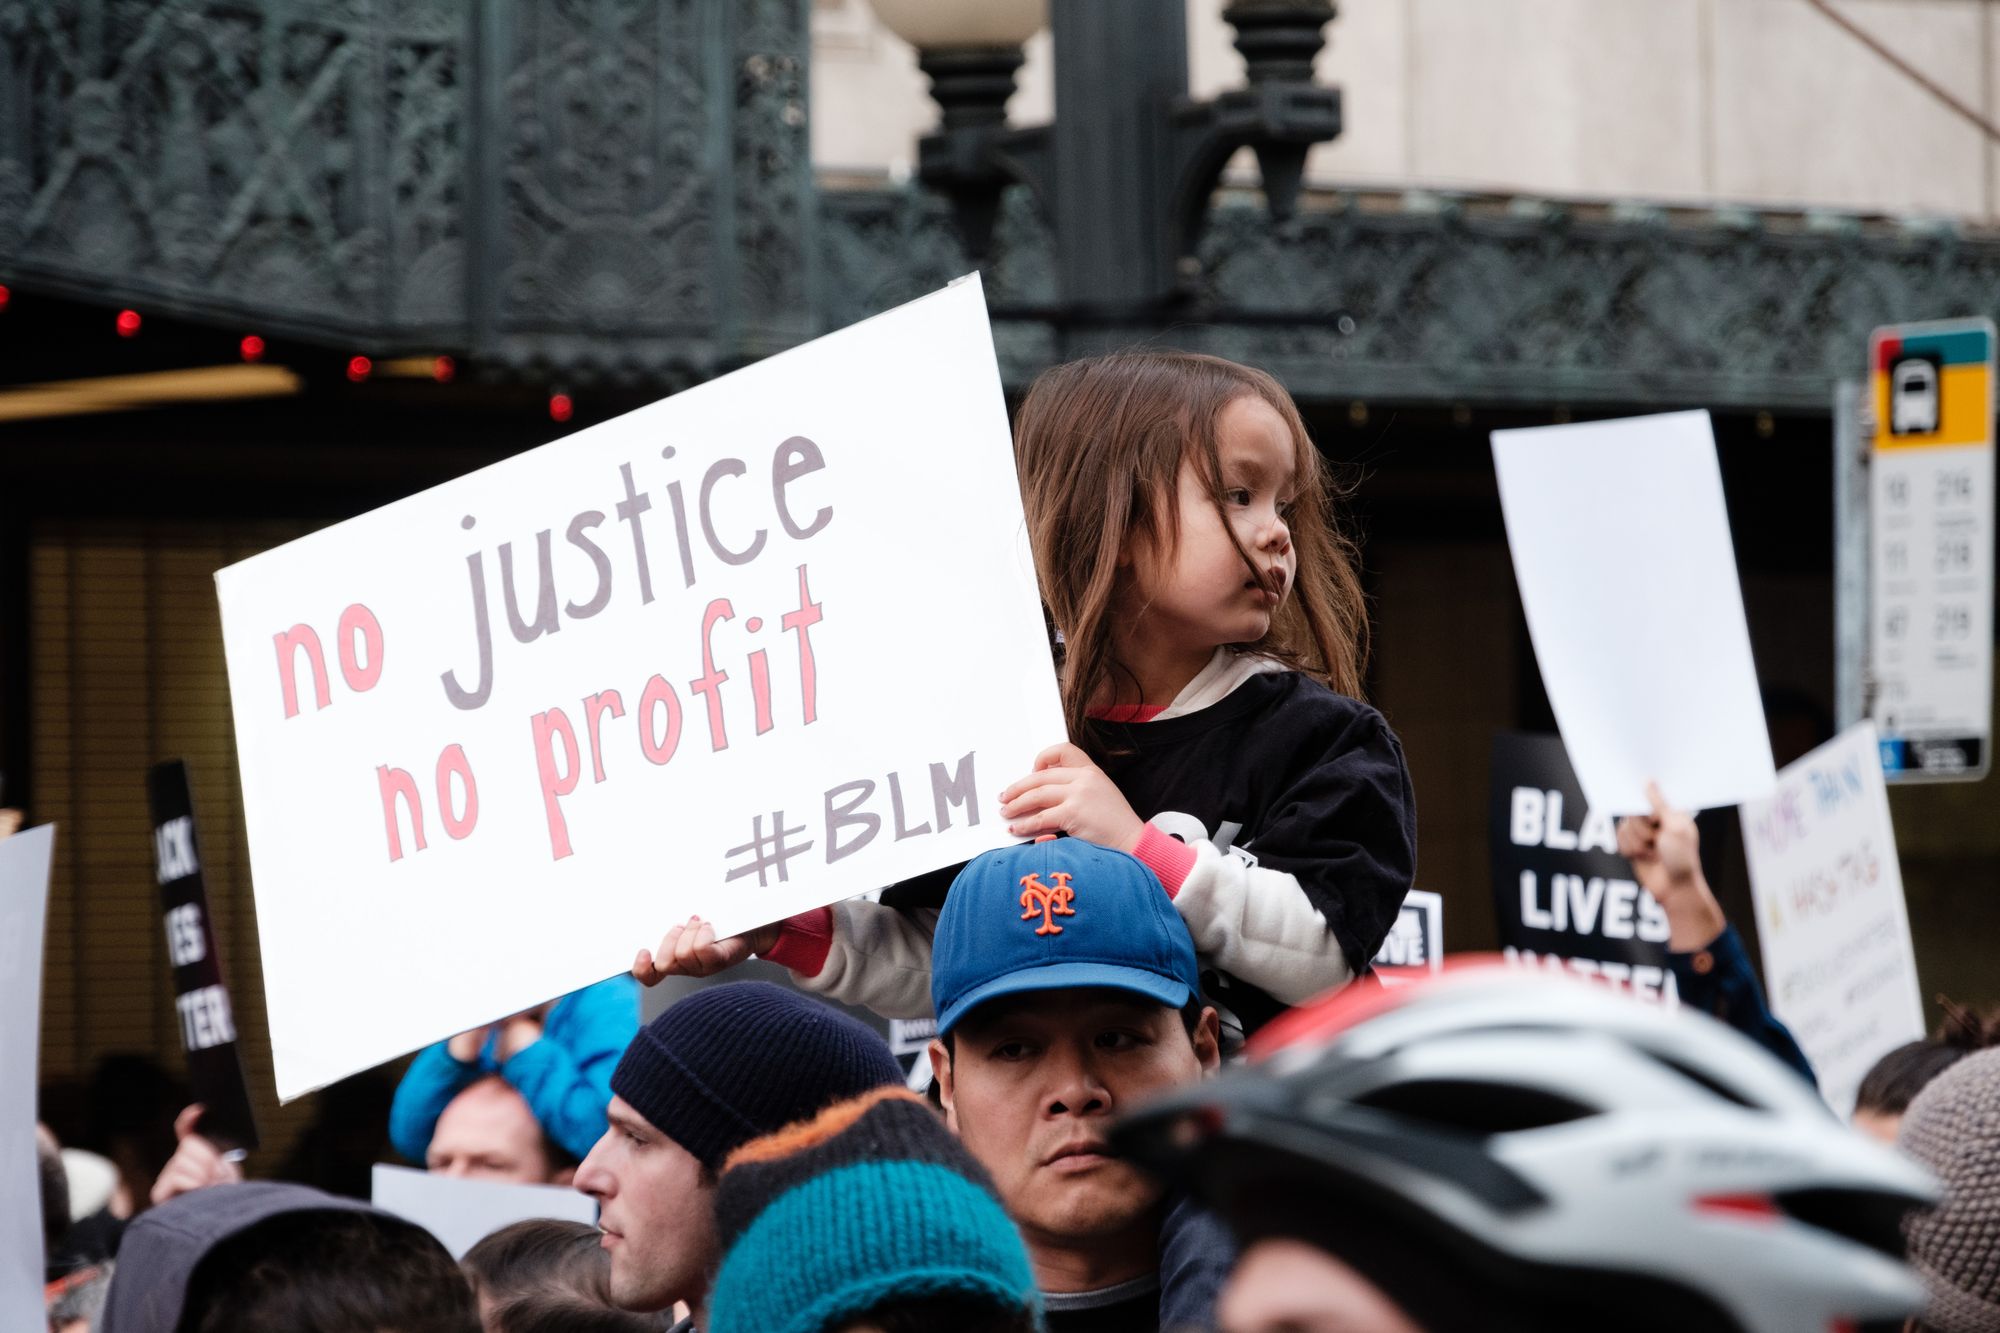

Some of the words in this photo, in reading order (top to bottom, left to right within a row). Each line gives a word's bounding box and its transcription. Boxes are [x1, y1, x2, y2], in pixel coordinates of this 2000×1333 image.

[273, 604, 384, 719] no
[441, 436, 833, 710] justice
[376, 744, 478, 862] no
[531, 564, 823, 861] profit
[725, 751, 980, 887] #BLM
[1520, 869, 1672, 943] LIVES
